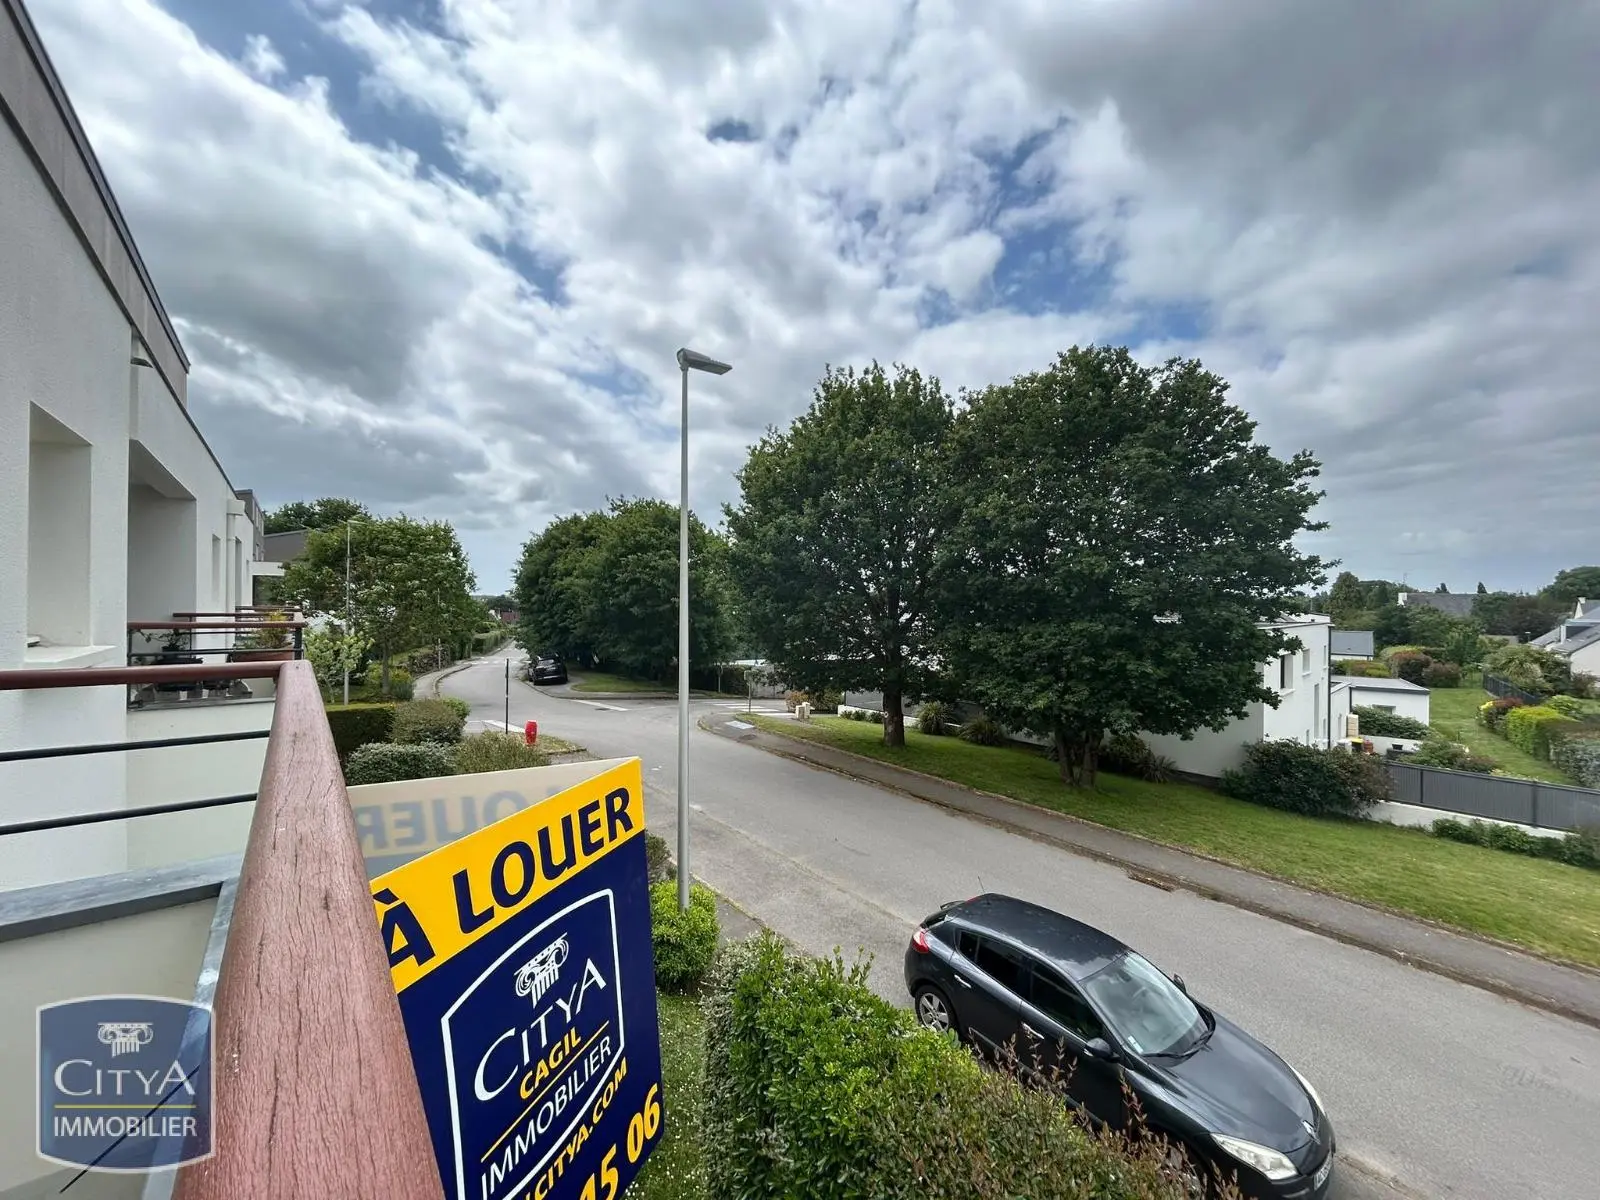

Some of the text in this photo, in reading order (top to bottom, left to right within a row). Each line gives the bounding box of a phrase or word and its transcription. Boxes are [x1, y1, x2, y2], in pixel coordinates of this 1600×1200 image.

[373, 787, 634, 968] À LOUER
[474, 958, 607, 1101] CITYA
[520, 1026, 581, 1099] CAGIL
[481, 1035, 612, 1200] IMMOBILIER
[526, 1056, 627, 1200] CITYA.COM
[627, 1083, 661, 1163] 06
